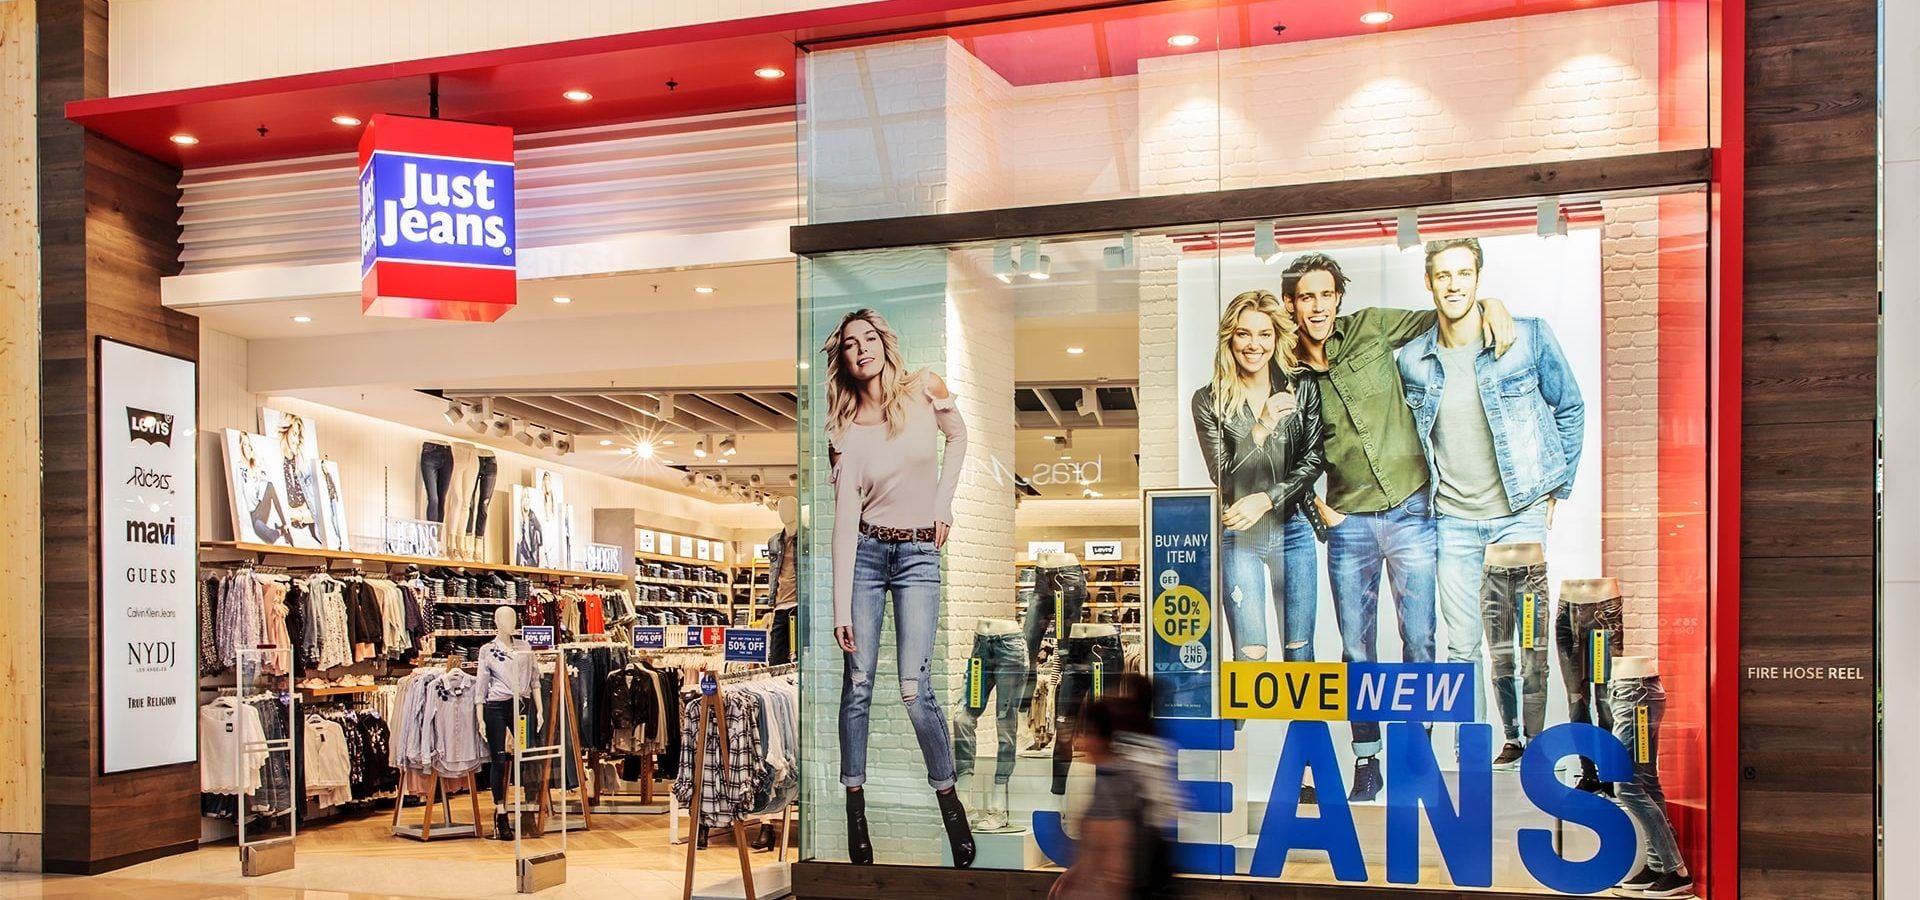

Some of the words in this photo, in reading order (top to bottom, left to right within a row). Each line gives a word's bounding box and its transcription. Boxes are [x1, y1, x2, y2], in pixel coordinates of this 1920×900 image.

[400, 163, 495, 210] Just
[380, 200, 507, 248] Jeans
[126, 517, 175, 545] mavi
[1155, 535, 1181, 548] BUY
[1184, 534, 1208, 547] ANY
[1167, 551, 1196, 563] ITEM
[126, 567, 176, 584] GUESS
[1162, 576, 1178, 584] GET
[1164, 595, 1200, 616] 50%
[1164, 618, 1200, 636] OFF
[539, 634, 551, 642] OFF
[650, 634, 662, 642] OFF
[728, 641, 746, 651] 50%
[748, 641, 764, 651] OFF
[1185, 645, 1202, 654] THE
[128, 642, 176, 667] NYDJ
[1184, 654, 1203, 664] 2ND
[1748, 667, 1779, 679] FIRE
[1783, 667, 1824, 679] HOSE
[1828, 667, 1864, 680] REEL
[1230, 672, 1339, 710] LOVE
[1356, 673, 1465, 711] NEW
[128, 697, 144, 709] TRUE
[147, 696, 176, 707] RELIGION
